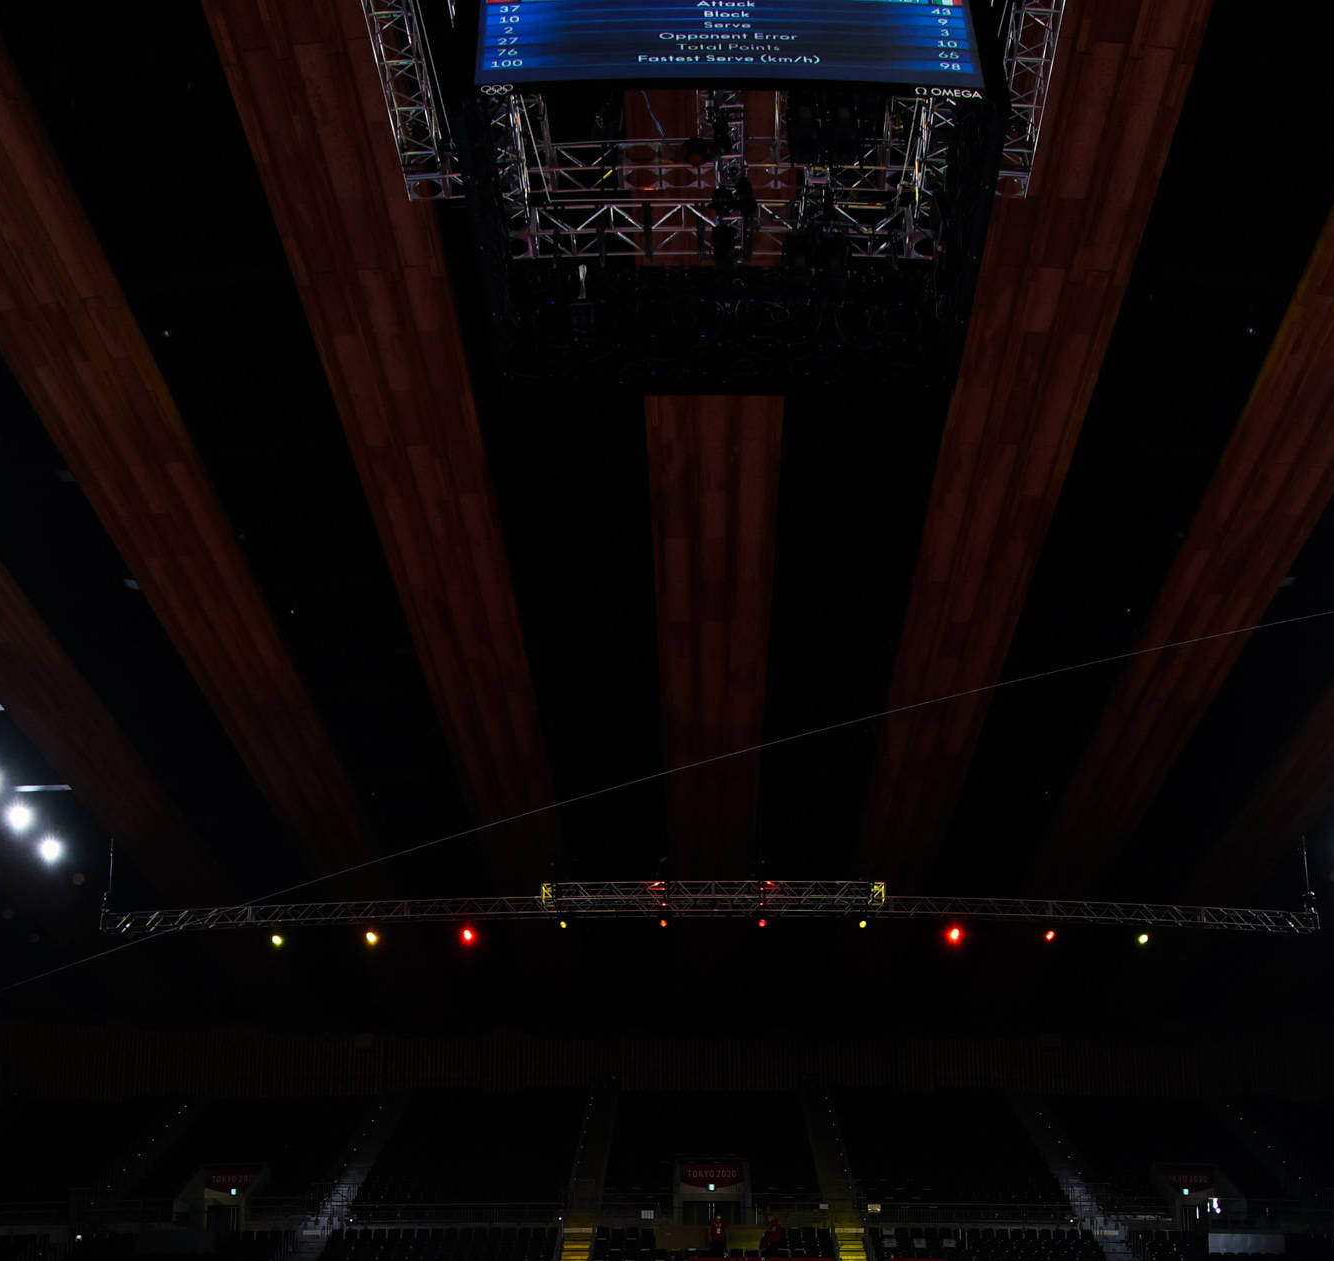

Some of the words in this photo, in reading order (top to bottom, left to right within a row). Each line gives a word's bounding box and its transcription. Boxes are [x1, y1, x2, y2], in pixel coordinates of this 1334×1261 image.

[697, 0, 755, 8] Attack
[499, 5, 520, 13] 37
[931, 8, 951, 16] 43
[704, 10, 750, 18] Block
[499, 15, 520, 24] 10
[938, 18, 948, 26] 9
[504, 26, 514, 35] 2
[940, 29, 950, 37] 3
[659, 32, 748, 41] Opponent
[754, 32, 799, 41] Error
[498, 37, 519, 46] 27
[937, 40, 958, 48] 10
[676, 43, 723, 51] Total
[728, 43, 780, 51] Points
[497, 48, 518, 57] 76
[491, 59, 523, 68] 100
[638, 55, 701, 63] Fastest
[706, 54, 755, 63] Serve
[760, 54, 820, 64] (km/h)
[940, 62, 961, 71] 98
[930, 88, 983, 99] OMEGA
